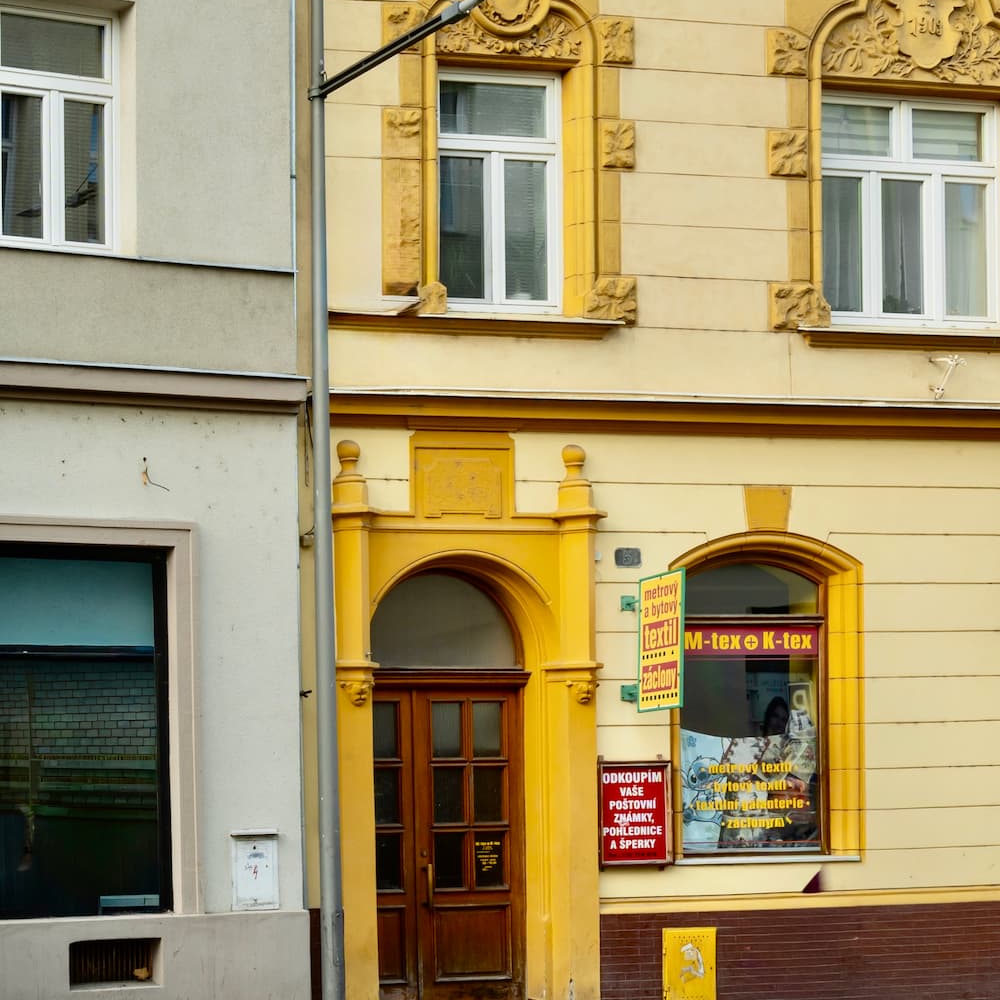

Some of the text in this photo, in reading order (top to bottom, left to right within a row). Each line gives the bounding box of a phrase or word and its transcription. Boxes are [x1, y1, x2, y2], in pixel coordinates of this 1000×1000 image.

[645, 582, 678, 600] metrový
[644, 599, 677, 618] a bytový
[644, 618, 677, 649] textil
[684, 631, 812, 650] M-tex K-tex
[643, 664, 676, 691] záclony
[708, 761, 792, 774] metrový textil
[603, 769, 662, 784] ODKOUPÍM
[619, 784, 644, 796] VAŠE
[714, 780, 787, 792] bytový textil
[609, 797, 656, 810] POŠTOVNÍ
[696, 796, 804, 811] textilní galanterie
[614, 811, 654, 824] ZNÁMKY,
[603, 825, 662, 836] POHLEDNICE
[610, 838, 656, 850] A ŠPERKY
